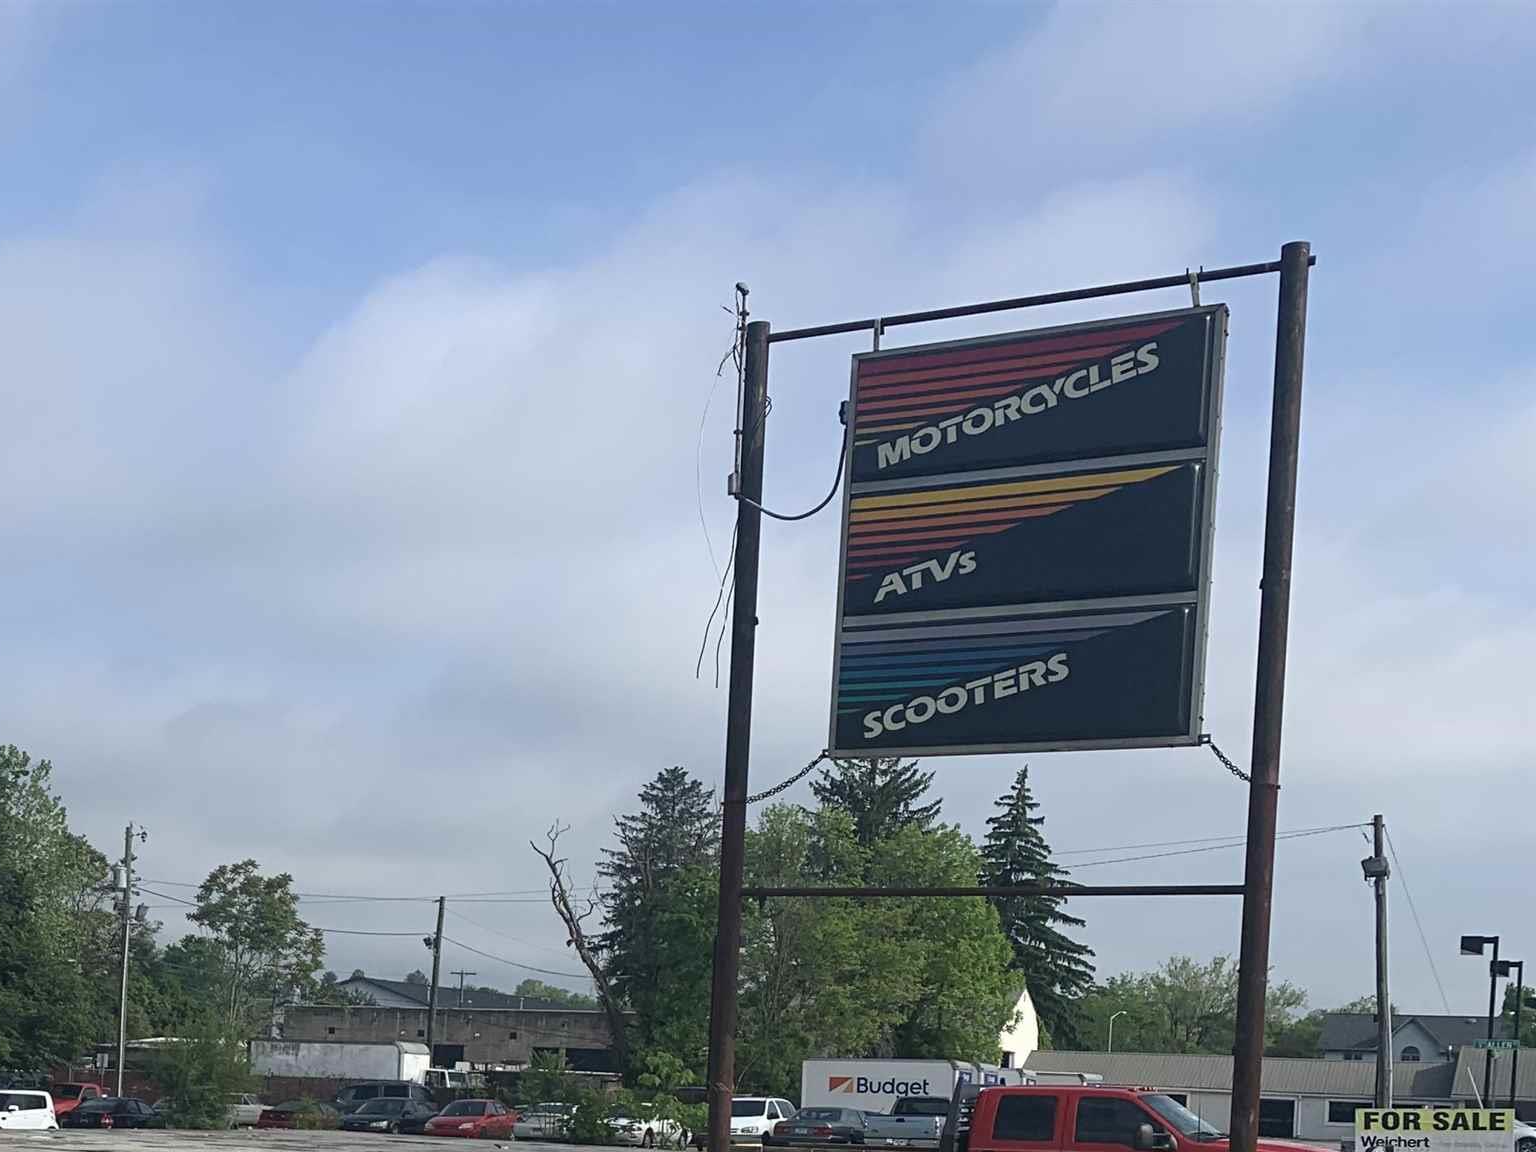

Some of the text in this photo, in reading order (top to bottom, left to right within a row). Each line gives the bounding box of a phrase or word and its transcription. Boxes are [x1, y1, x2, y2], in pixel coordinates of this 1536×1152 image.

[876, 341, 1161, 470] MOTORCYCLES
[873, 549, 977, 604] ATVs
[863, 652, 1070, 739] SCOOTERS
[856, 1076, 930, 1097] Budget
[1363, 1111, 1506, 1131] FOR SALE
[1360, 1135, 1431, 1149] Weichert
